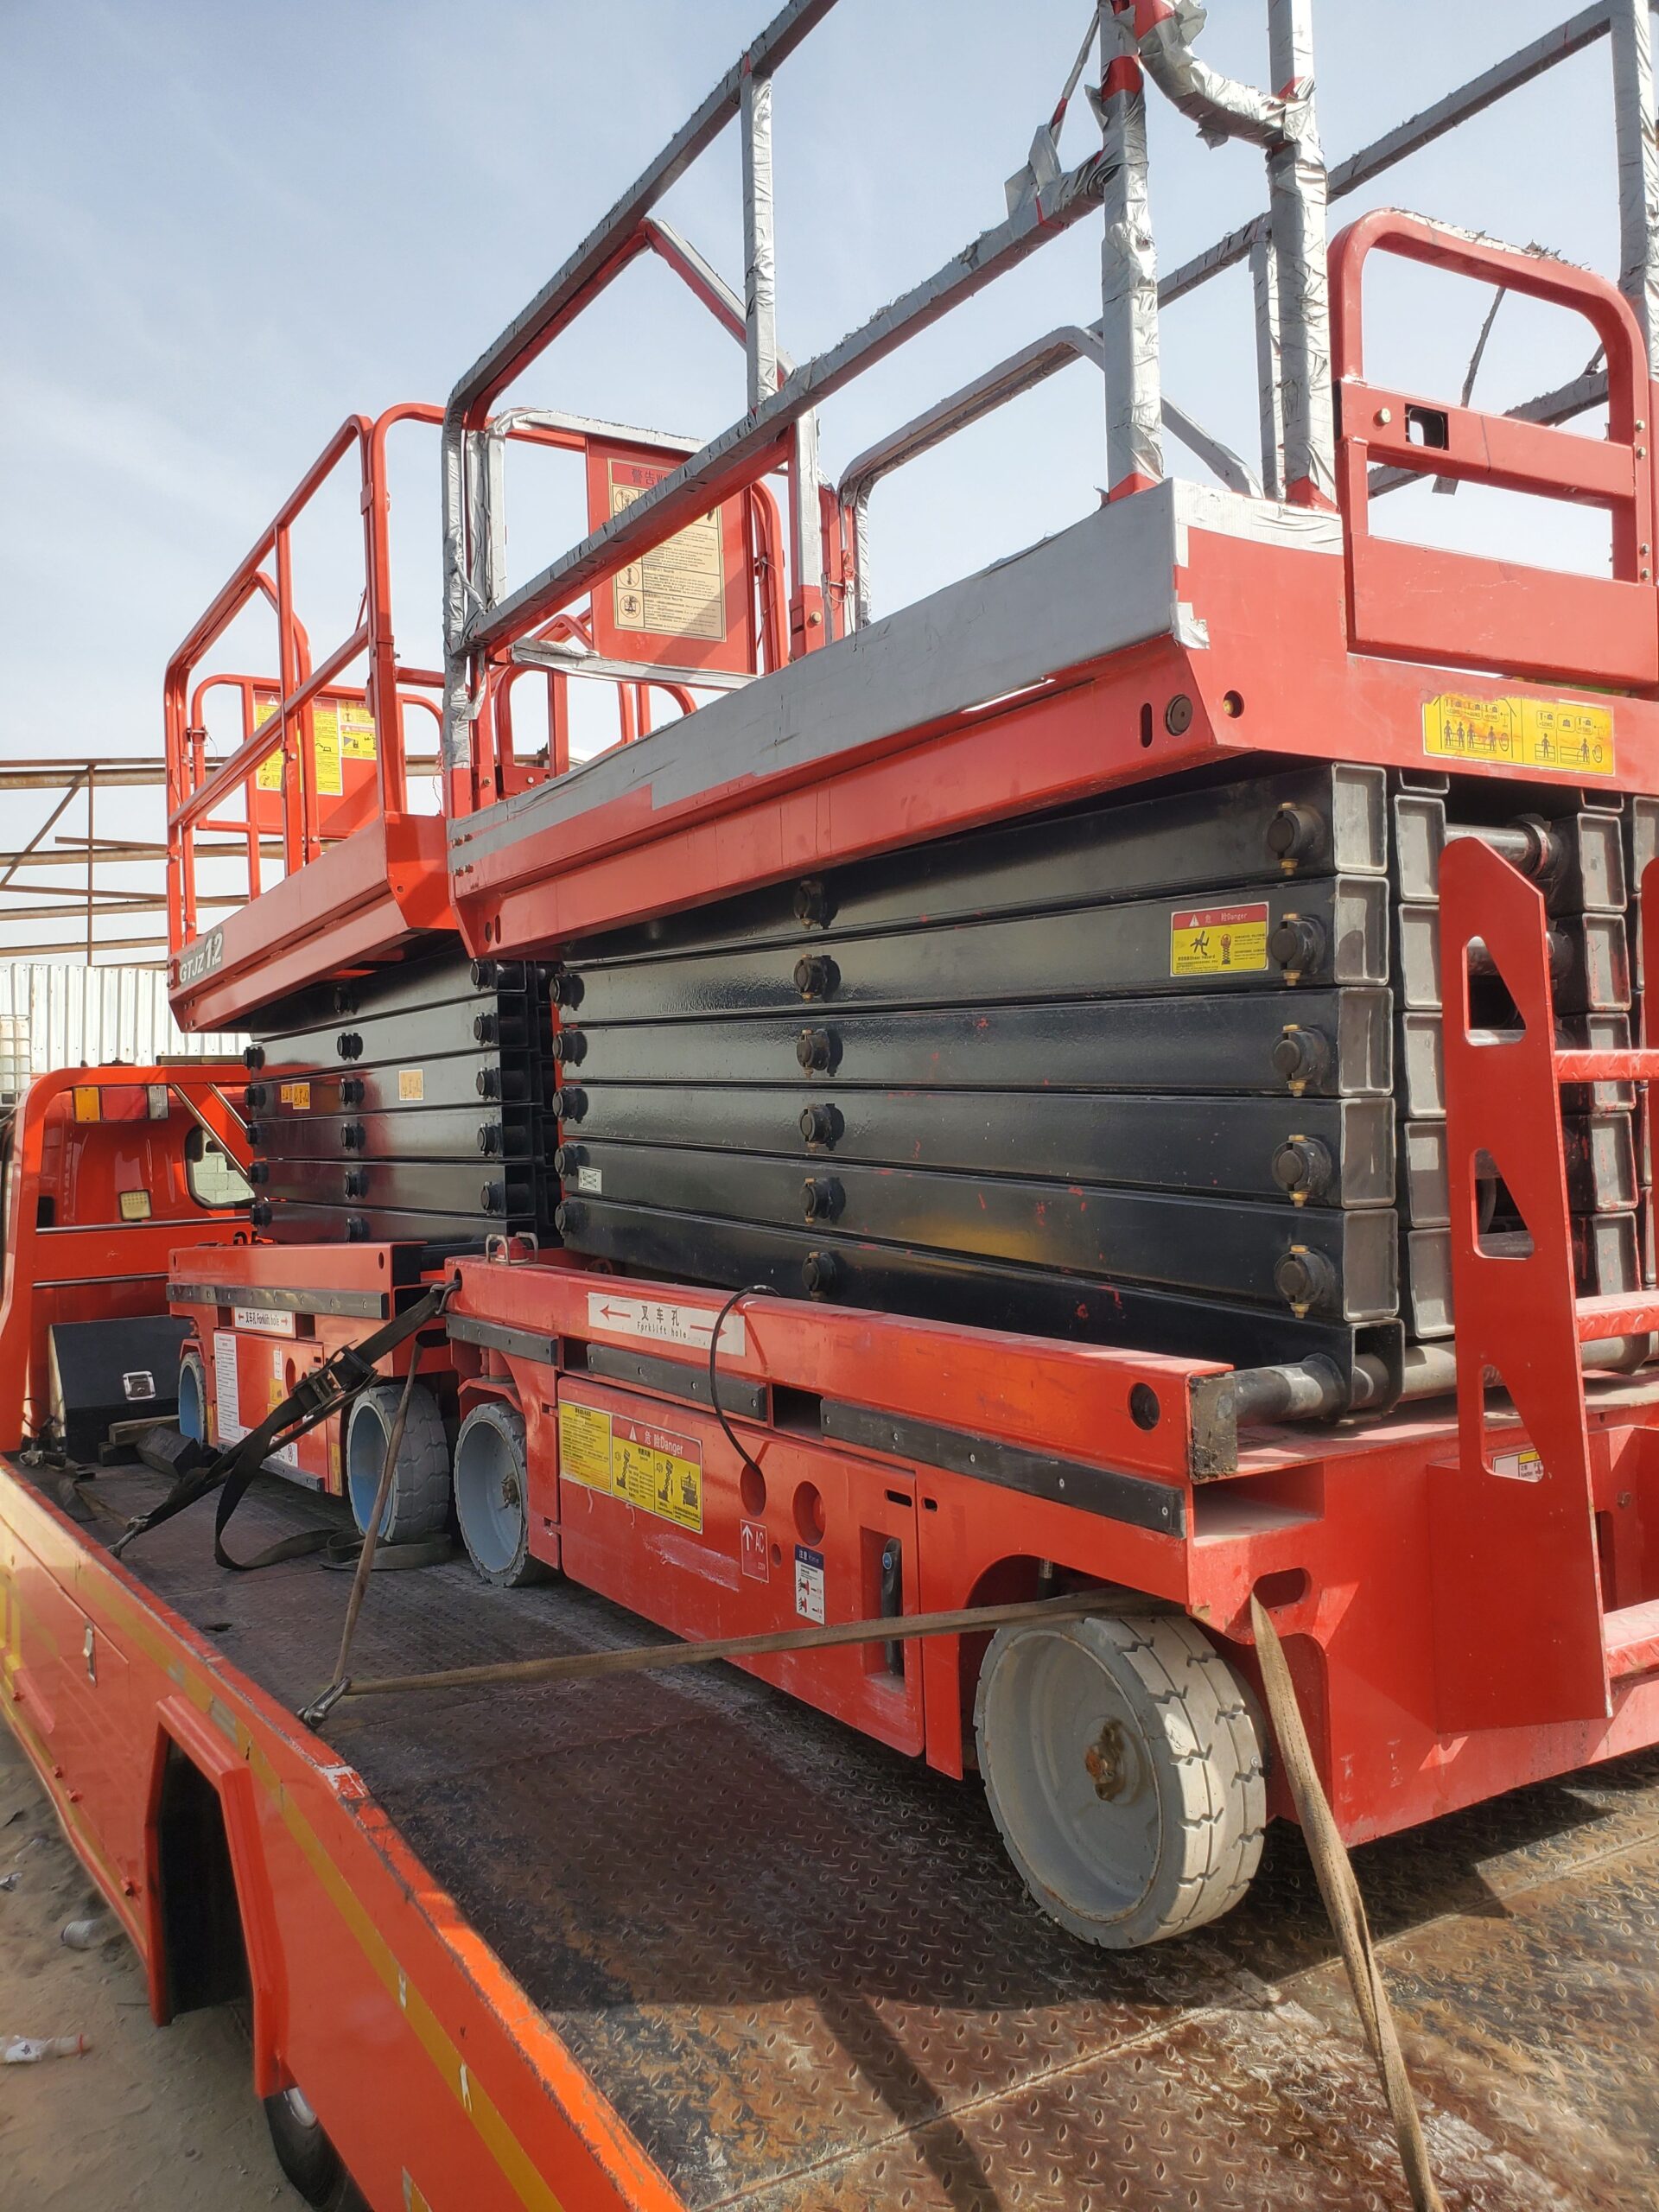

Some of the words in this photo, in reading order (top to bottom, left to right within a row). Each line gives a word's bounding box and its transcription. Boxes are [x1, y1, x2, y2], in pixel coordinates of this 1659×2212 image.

[637, 1320, 667, 1336] Forklift
[671, 1326, 687, 1339] hole
[660, 1434, 683, 1457] Danger
[754, 1530, 765, 1554] AC
